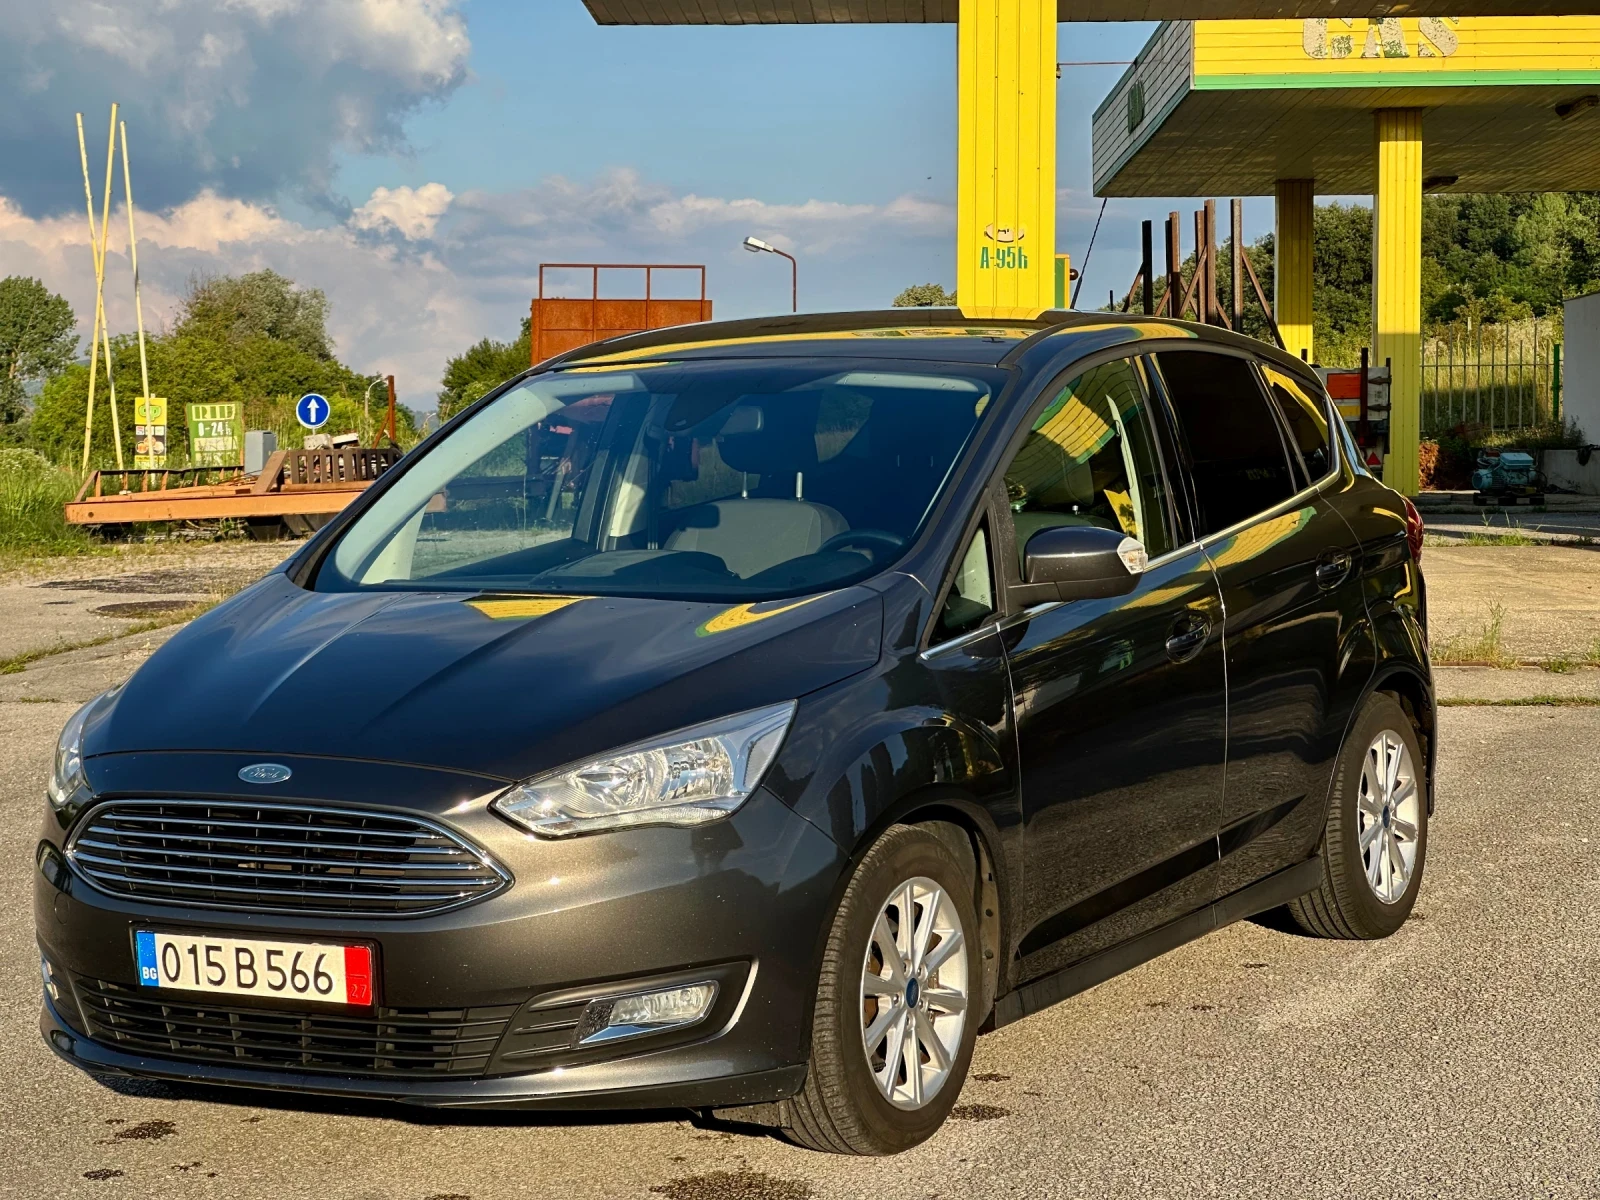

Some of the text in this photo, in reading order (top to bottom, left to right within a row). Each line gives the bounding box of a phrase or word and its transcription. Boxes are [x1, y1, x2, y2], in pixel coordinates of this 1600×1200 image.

[1303, 17, 1459, 59] GAS
[142, 966, 158, 980] BG
[351, 983, 367, 998] 27
